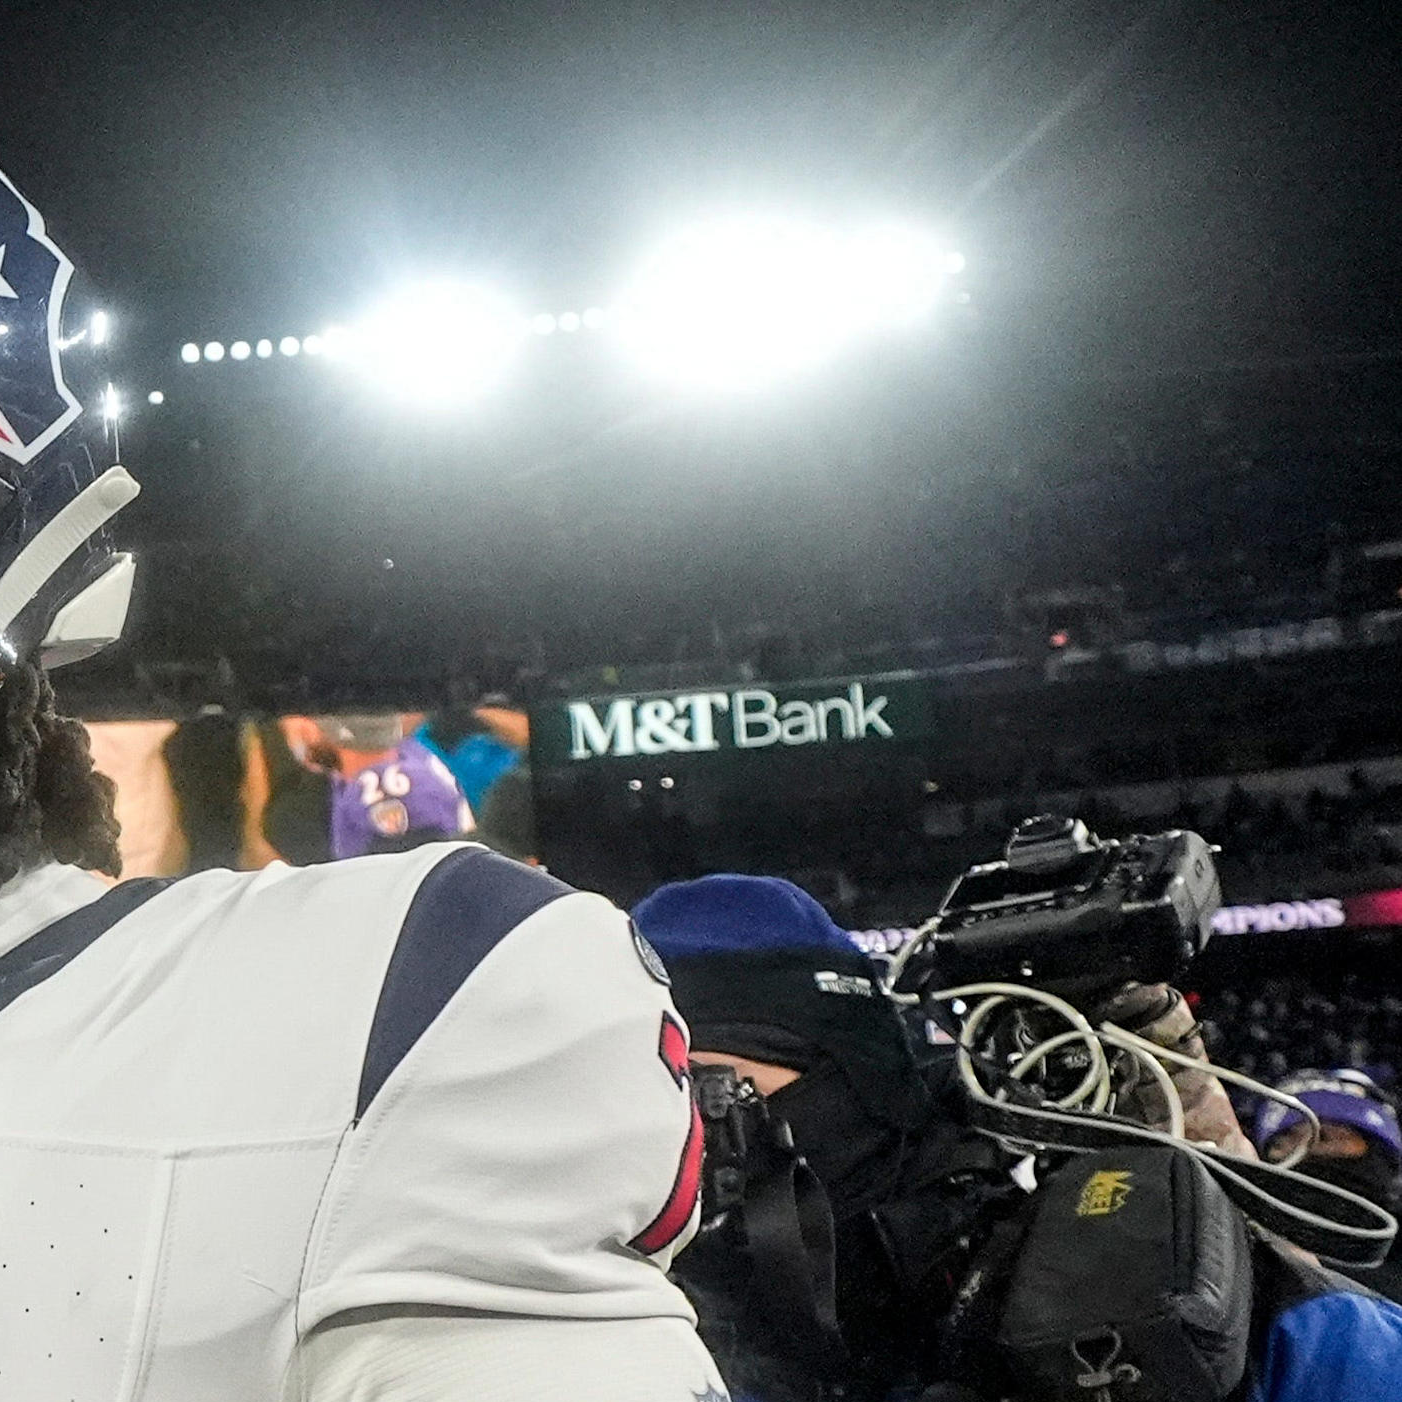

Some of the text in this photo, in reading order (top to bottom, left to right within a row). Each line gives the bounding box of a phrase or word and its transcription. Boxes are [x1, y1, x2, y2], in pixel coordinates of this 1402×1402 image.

[568, 682, 894, 760] M&T Bank
[358, 764, 411, 807] 26
